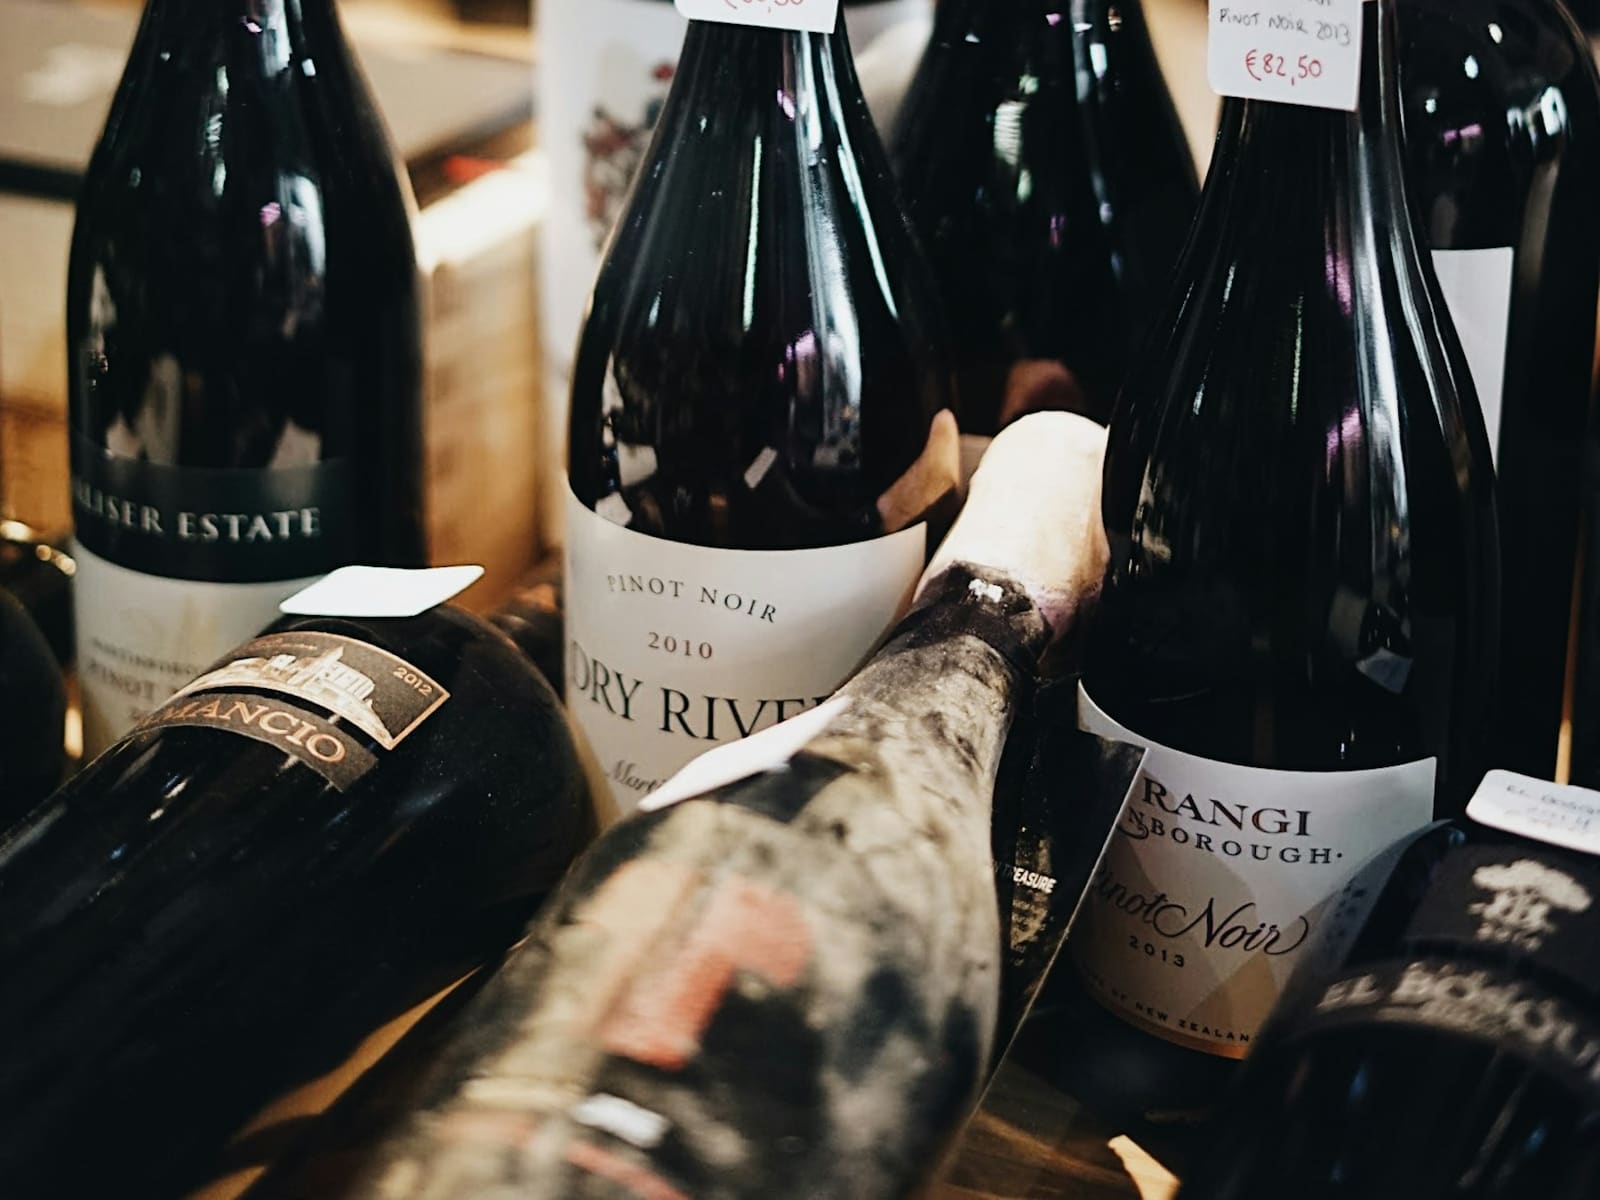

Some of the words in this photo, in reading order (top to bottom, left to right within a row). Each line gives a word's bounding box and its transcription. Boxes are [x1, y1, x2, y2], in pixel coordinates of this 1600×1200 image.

[1316, 21, 1351, 46] 2013
[1245, 49, 1322, 86] €82,50
[177, 507, 321, 543] ESTATE
[607, 574, 684, 598] PINOT
[700, 586, 777, 623] NOIR
[648, 632, 713, 660] 2010
[393, 667, 432, 697] 2012
[571, 641, 643, 721] DRY
[606, 759, 664, 793] Marti
[1143, 777, 1311, 836] RANGI
[1099, 866, 1168, 923] inot
[1153, 897, 1309, 955] Noir
[1129, 935, 1184, 968] 2013
[1136, 1002, 1169, 1021] NEW
[1178, 1018, 1250, 1042] ZEALAN
